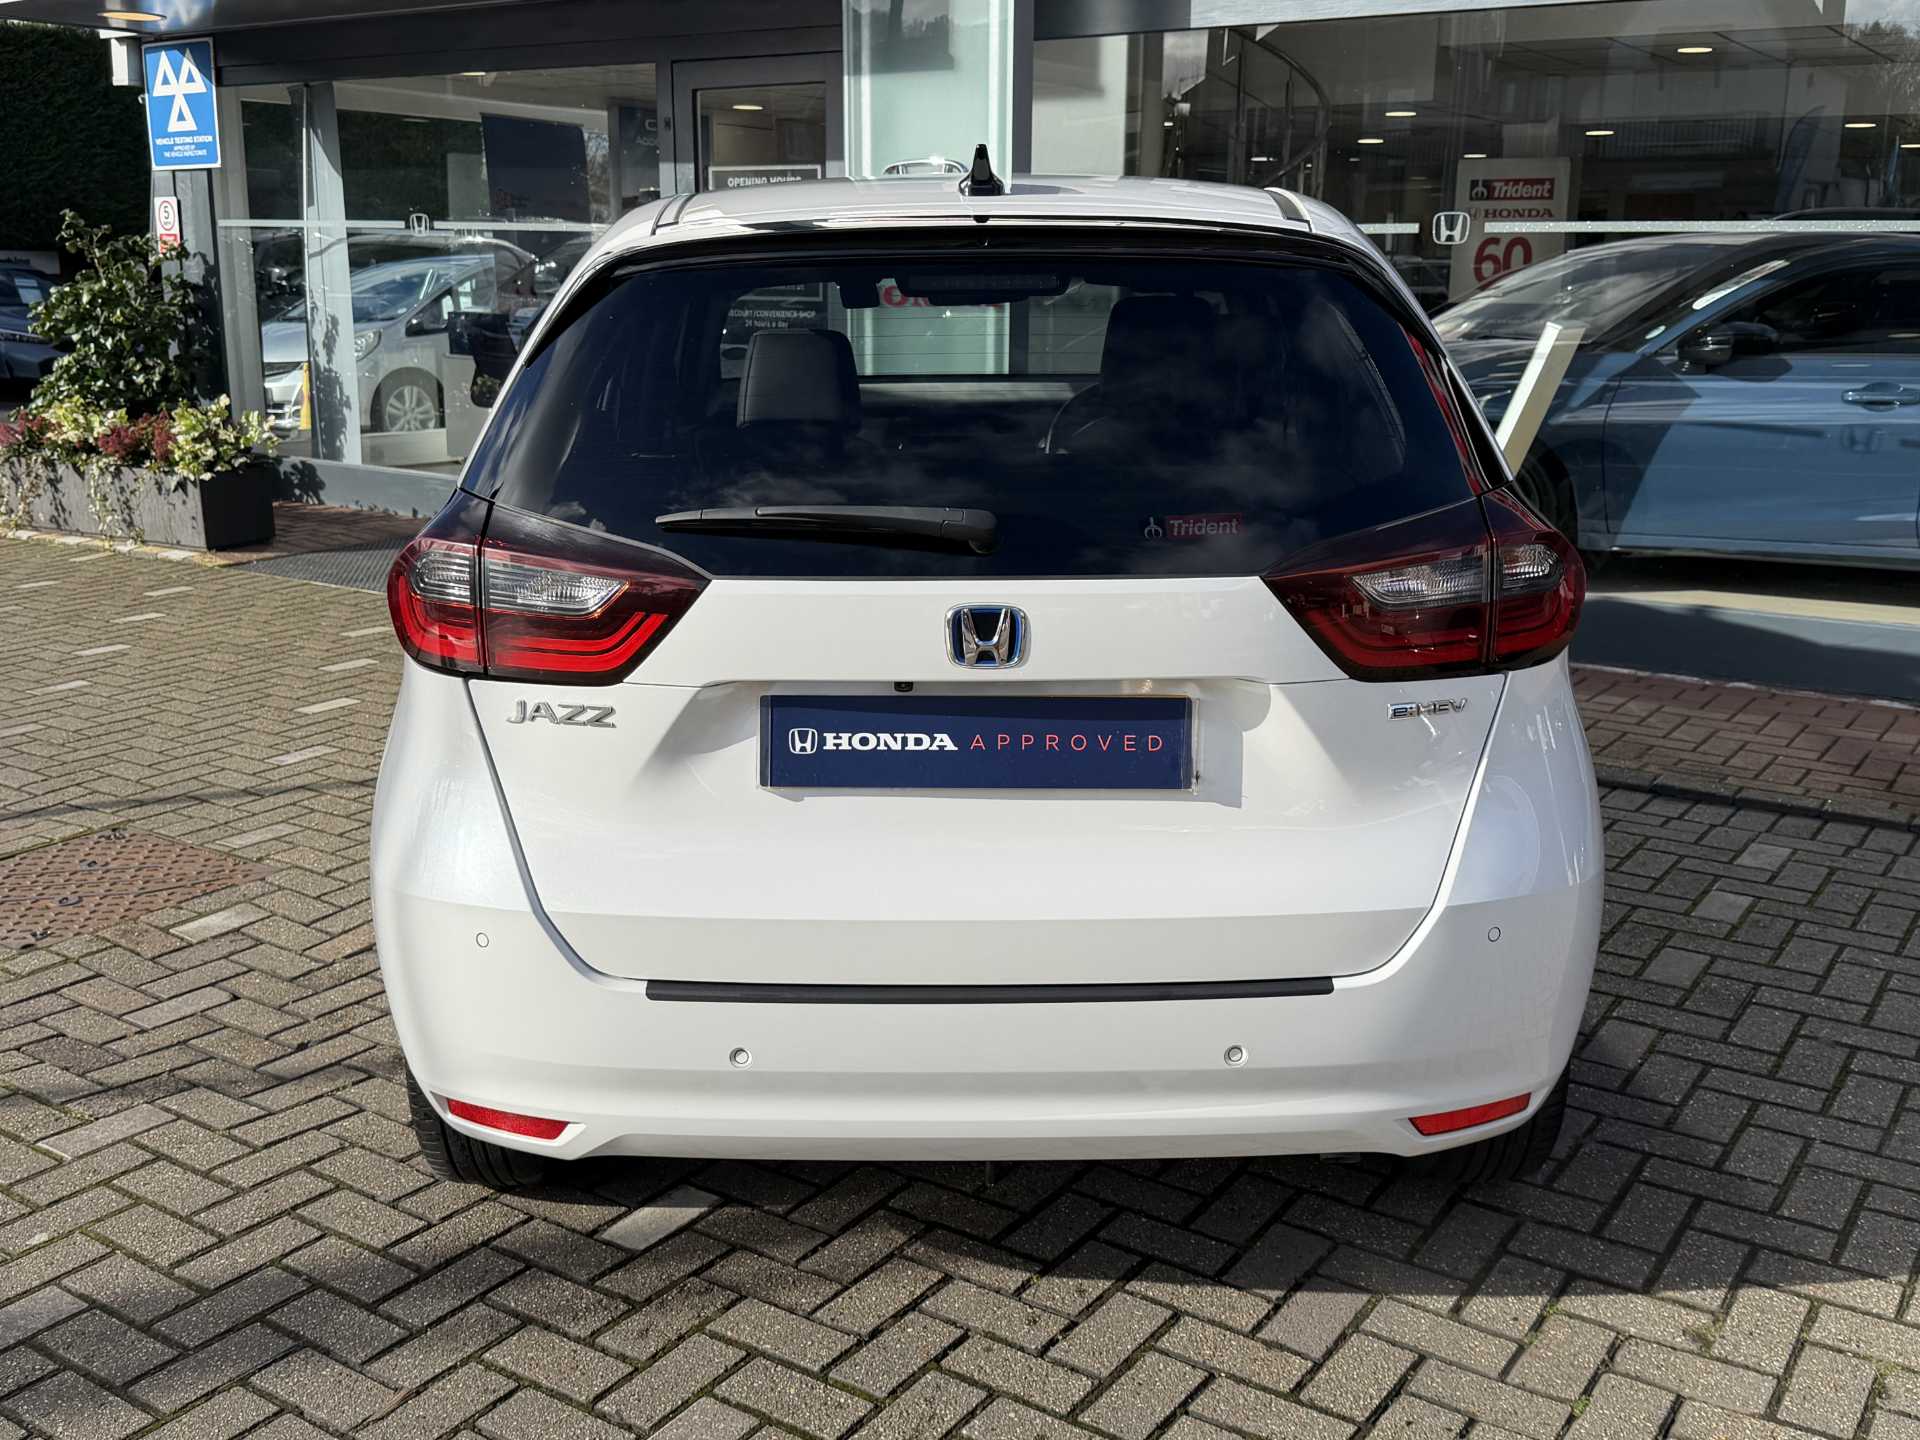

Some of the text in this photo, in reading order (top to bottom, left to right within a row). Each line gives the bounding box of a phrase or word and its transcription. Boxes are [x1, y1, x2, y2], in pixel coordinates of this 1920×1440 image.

[1491, 181, 1552, 199] Trident
[163, 205, 170, 220] 5
[1483, 207, 1553, 219] HONDA
[1473, 236, 1533, 285] 60
[1168, 518, 1240, 537] Trident
[505, 699, 617, 728] JAZZ
[823, 731, 1163, 752] HONDA APPROVED
